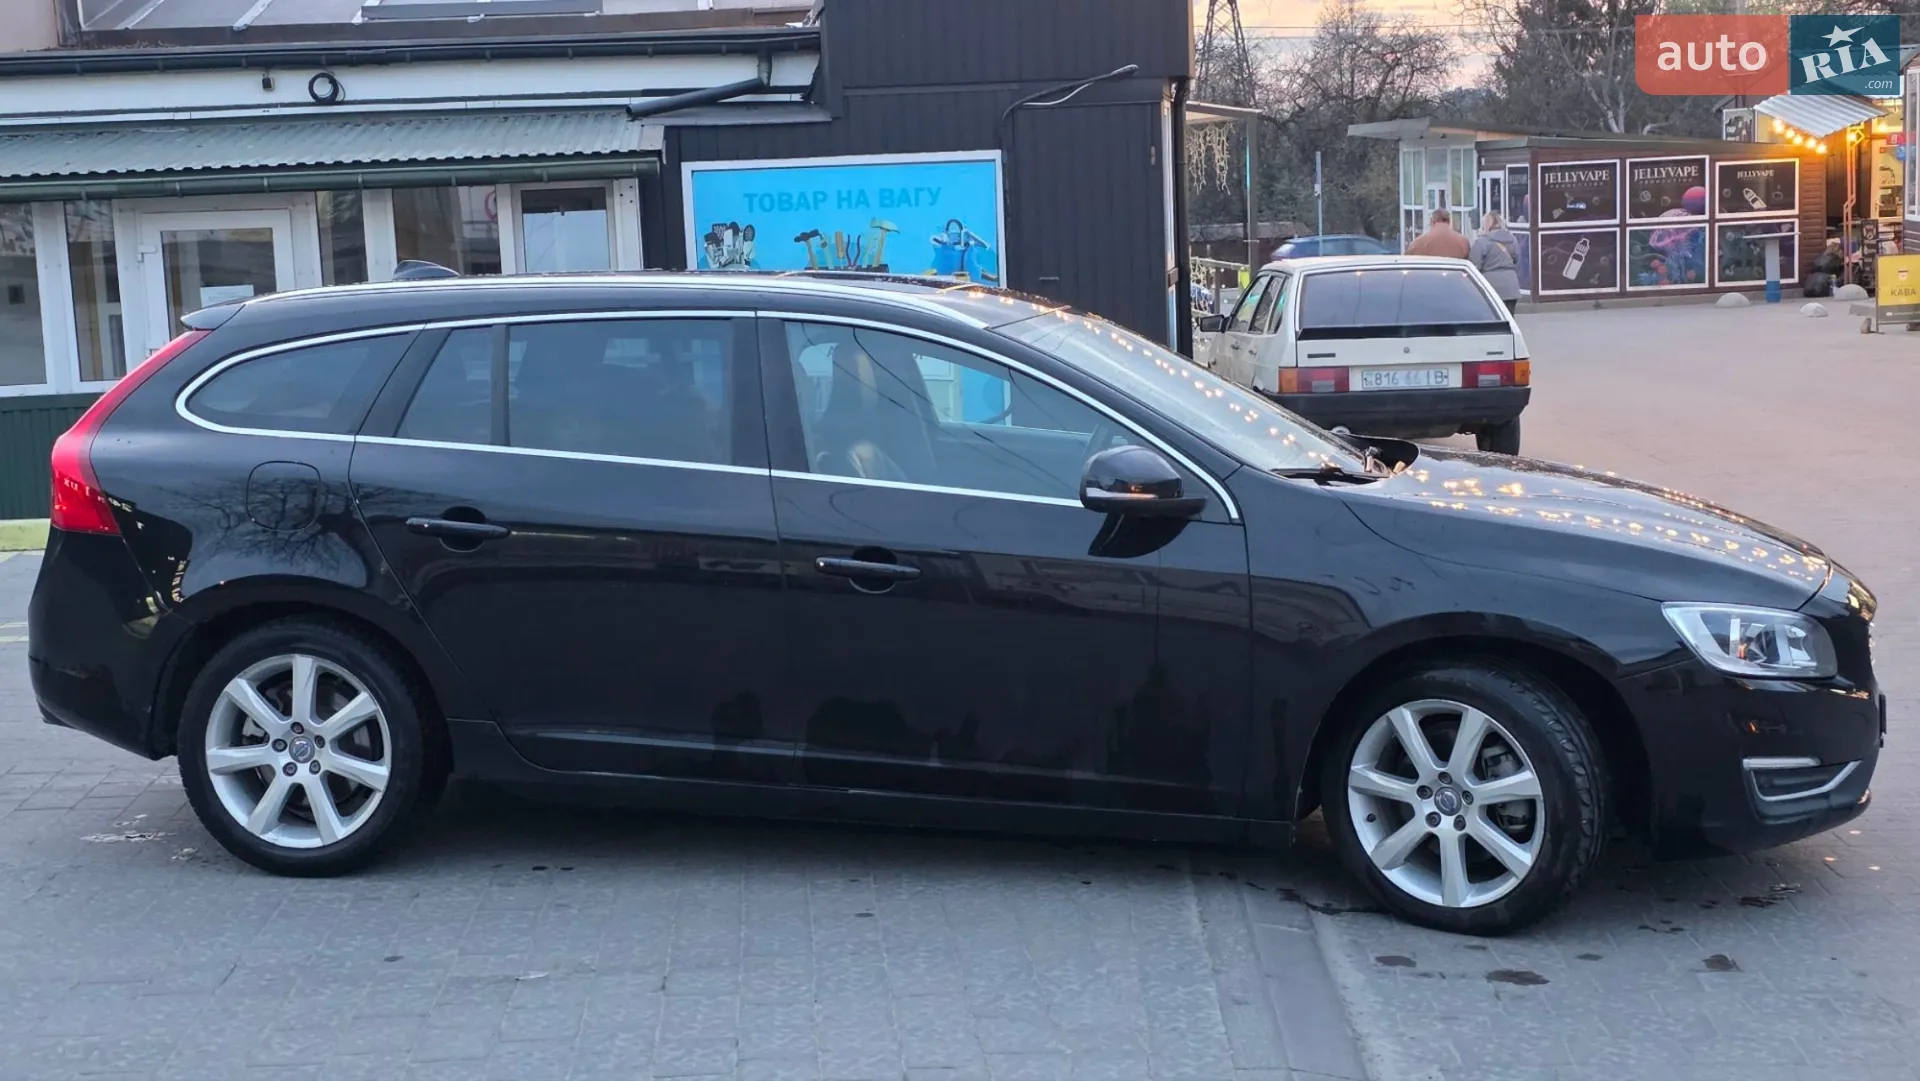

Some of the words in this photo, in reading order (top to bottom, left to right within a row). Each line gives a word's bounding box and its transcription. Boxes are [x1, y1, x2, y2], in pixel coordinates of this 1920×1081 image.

[1544, 169, 1611, 186] JELLYVAPE
[1633, 165, 1700, 182] JELLYVAPE
[743, 190, 828, 214] ТОВАР
[837, 189, 871, 210] НА
[879, 186, 942, 209] ВАГУ
[1890, 287, 1917, 298] КАВА
